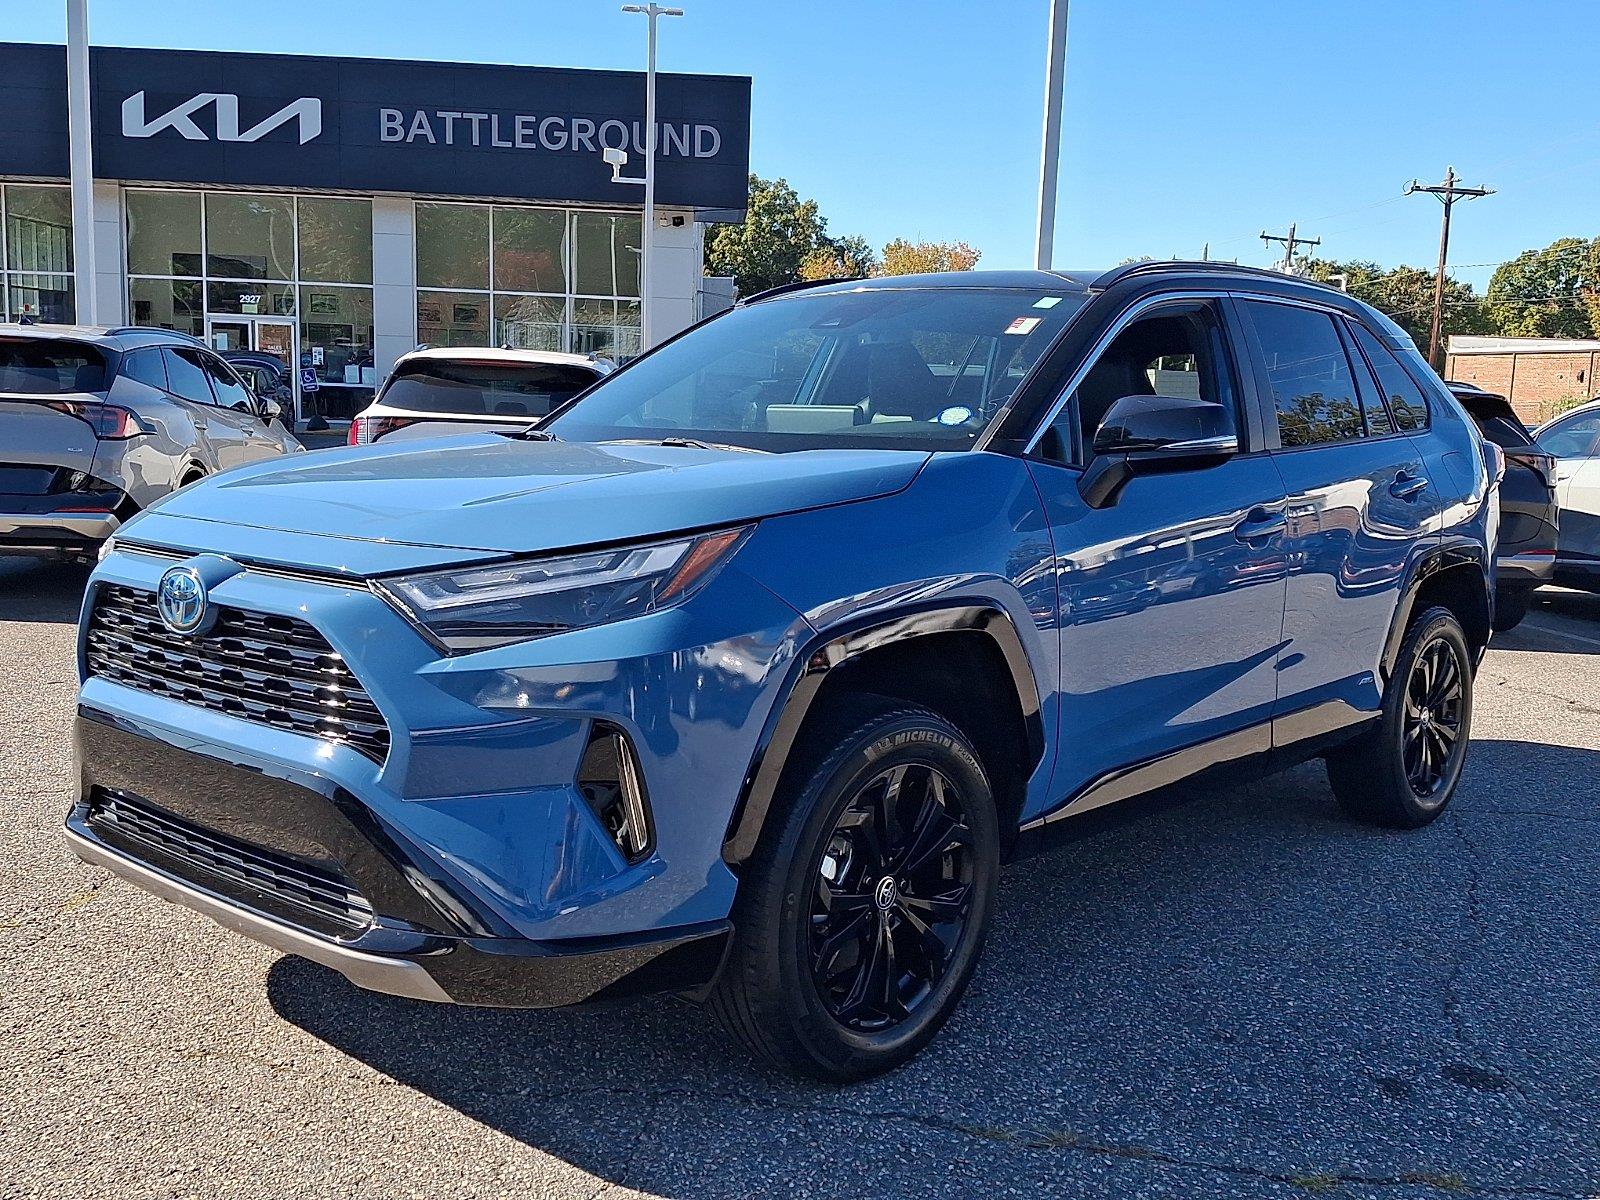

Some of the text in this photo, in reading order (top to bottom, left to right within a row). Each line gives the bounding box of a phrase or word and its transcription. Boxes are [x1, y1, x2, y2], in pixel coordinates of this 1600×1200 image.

[379, 107, 722, 159] BATTLEGROUND
[239, 294, 261, 303] 2927
[895, 730, 951, 748] MICHELIN
